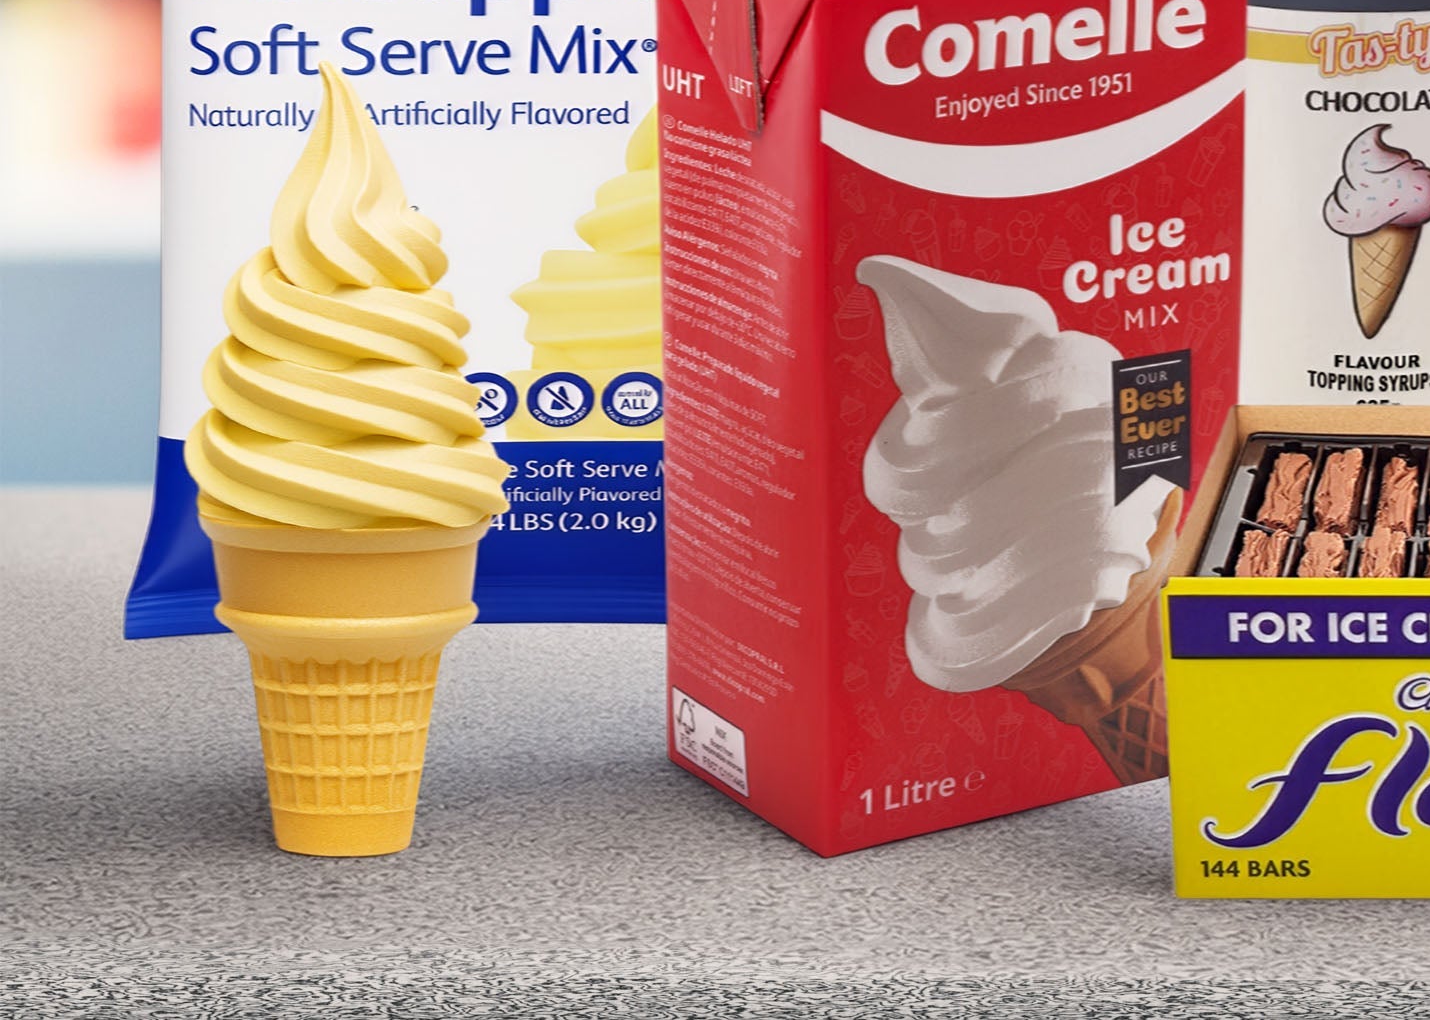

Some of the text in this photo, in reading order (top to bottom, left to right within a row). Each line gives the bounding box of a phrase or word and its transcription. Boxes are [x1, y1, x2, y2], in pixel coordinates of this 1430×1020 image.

[189, 23, 320, 76] Soft
[341, 26, 512, 76] Serve
[662, 64, 705, 100] UHT
[728, 73, 753, 98] LIFT
[935, 72, 1132, 121] Enjoyed Since 1951
[188, 100, 630, 132] Naturally Artificially Flavored
[1109, 214, 1186, 256] Ice
[1063, 252, 1230, 304] Cream
[1124, 302, 1179, 331] MIX
[1334, 355, 1420, 370] FLAVOUR
[1135, 370, 1168, 385] OUR
[1307, 369, 1375, 392] TOPPING
[620, 398, 649, 410] ALL
[1119, 380, 1186, 415] Best
[1120, 415, 1187, 444] Ever
[1128, 441, 1178, 459] RECIPE
[525, 458, 575, 478] Soft
[582, 459, 648, 478] Serve
[509, 513, 554, 531] LBS
[558, 512, 610, 533] (2.0
[616, 511, 658, 533] kg)
[1228, 611, 1314, 644] FOR
[1327, 611, 1388, 644] ICE
[859, 788, 873, 815] 1
[884, 777, 956, 811] Litre
[1200, 860, 1311, 878] 144 BARS
